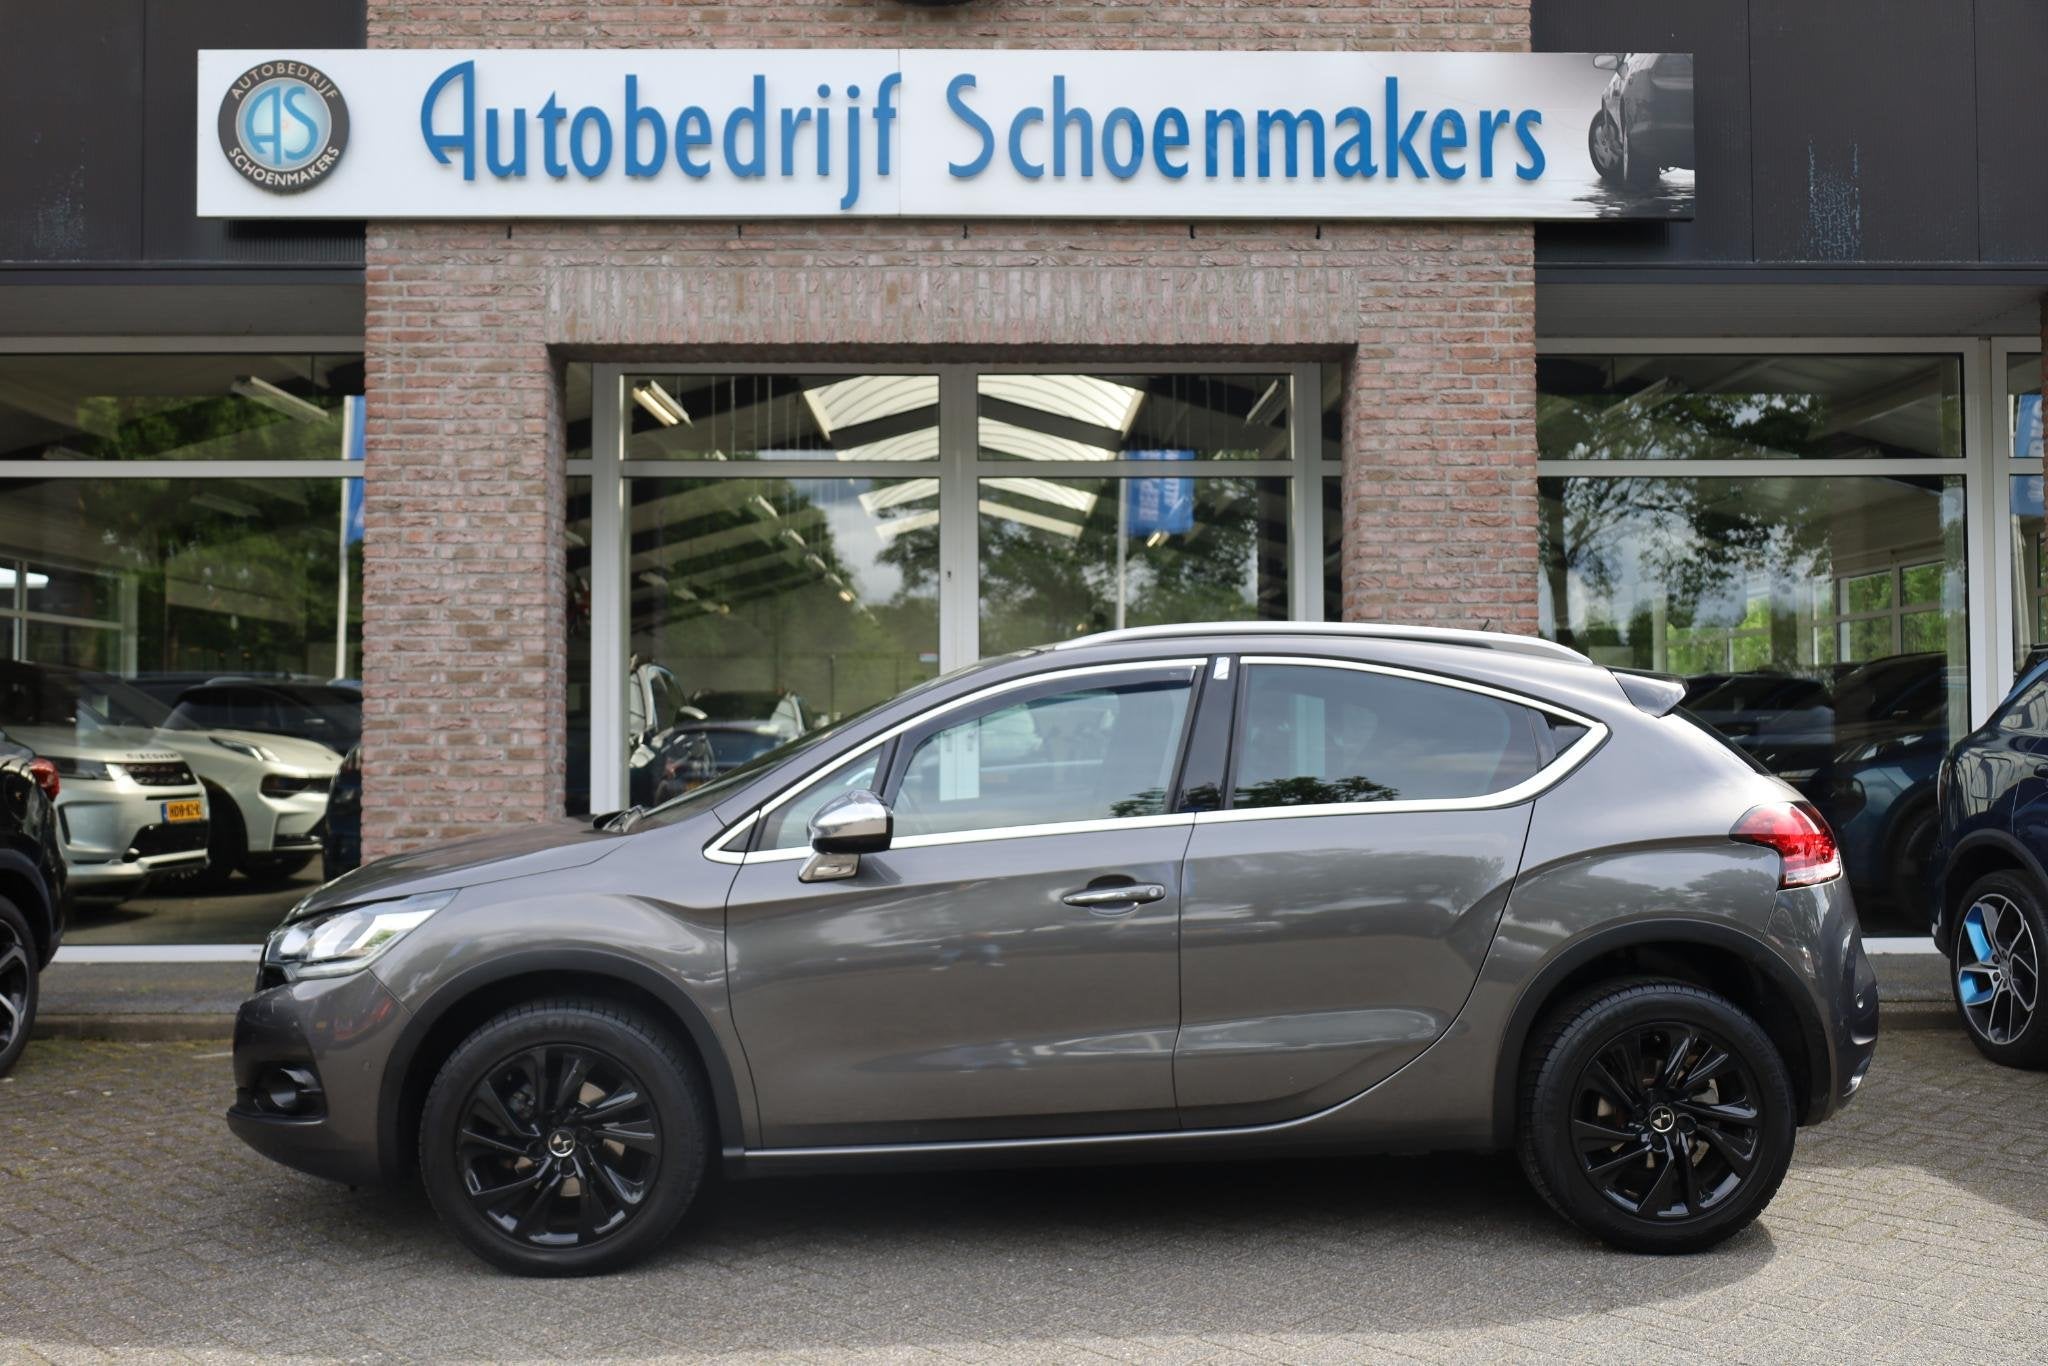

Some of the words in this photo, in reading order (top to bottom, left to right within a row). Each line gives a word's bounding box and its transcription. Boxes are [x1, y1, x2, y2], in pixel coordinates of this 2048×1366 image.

[231, 62, 338, 100] AUTOBEDRIJF
[245, 86, 319, 165] AS
[420, 60, 903, 211] Autobedrijf
[946, 73, 1546, 180] Schoenmakers
[228, 145, 340, 187] SCHOENMAKERS
